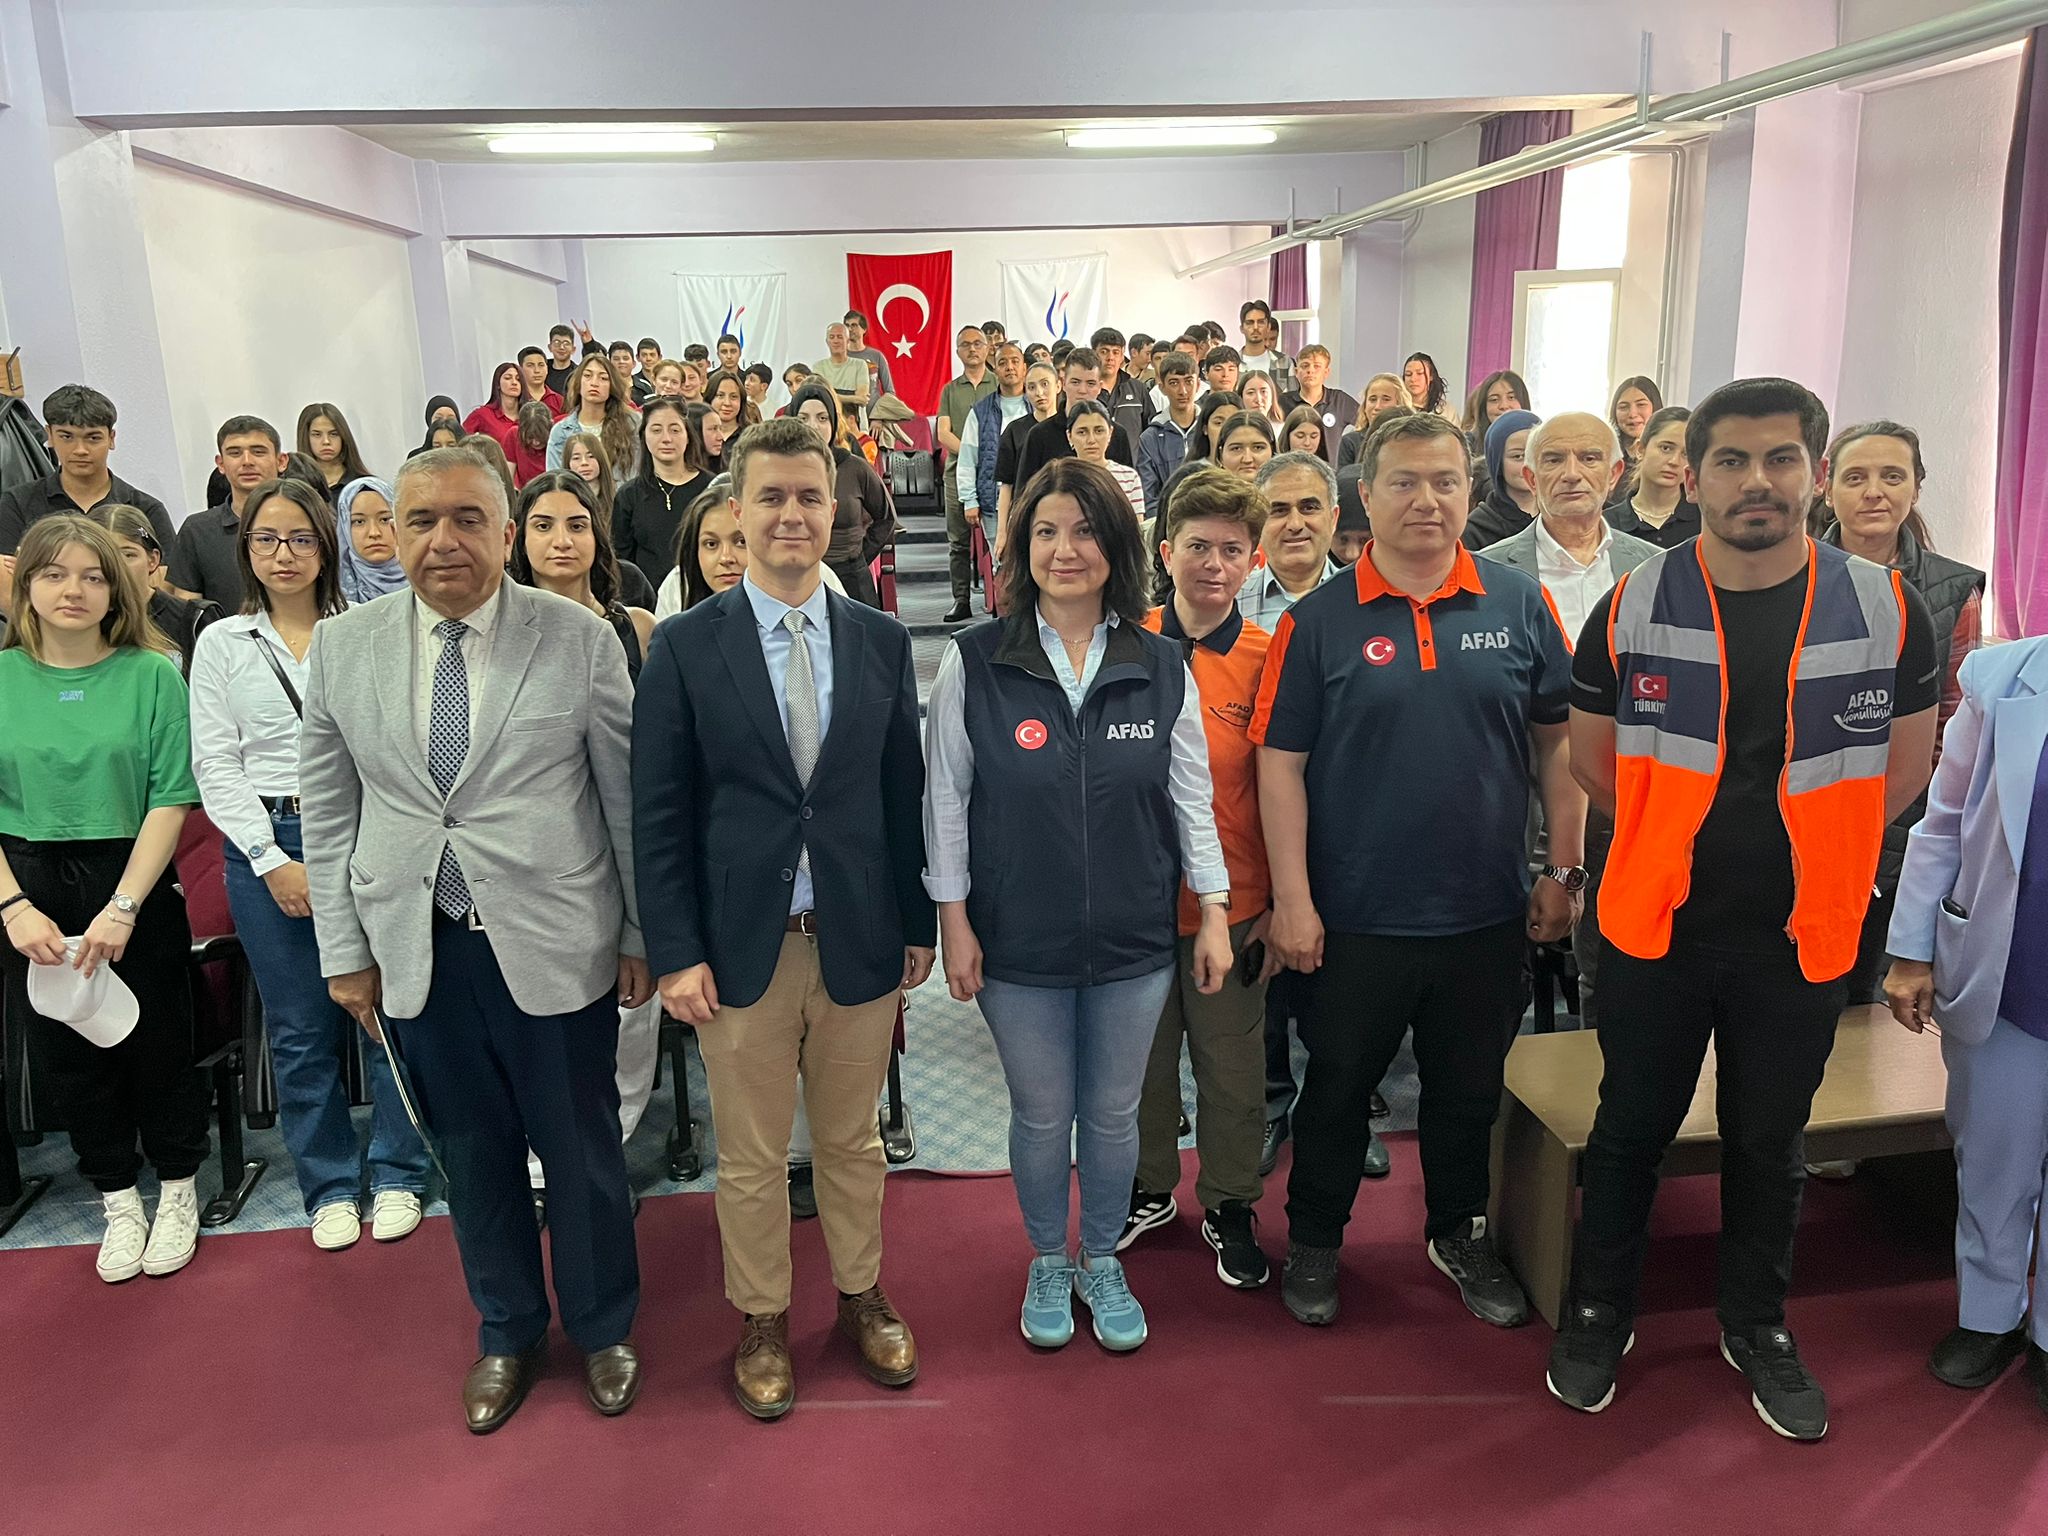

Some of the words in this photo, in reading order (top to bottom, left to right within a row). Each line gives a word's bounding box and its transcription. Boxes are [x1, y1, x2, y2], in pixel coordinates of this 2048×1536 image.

[1460, 631, 1510, 651] AFAD
[1848, 689, 1888, 710] AFAD
[1106, 722, 1155, 740] AFAD
